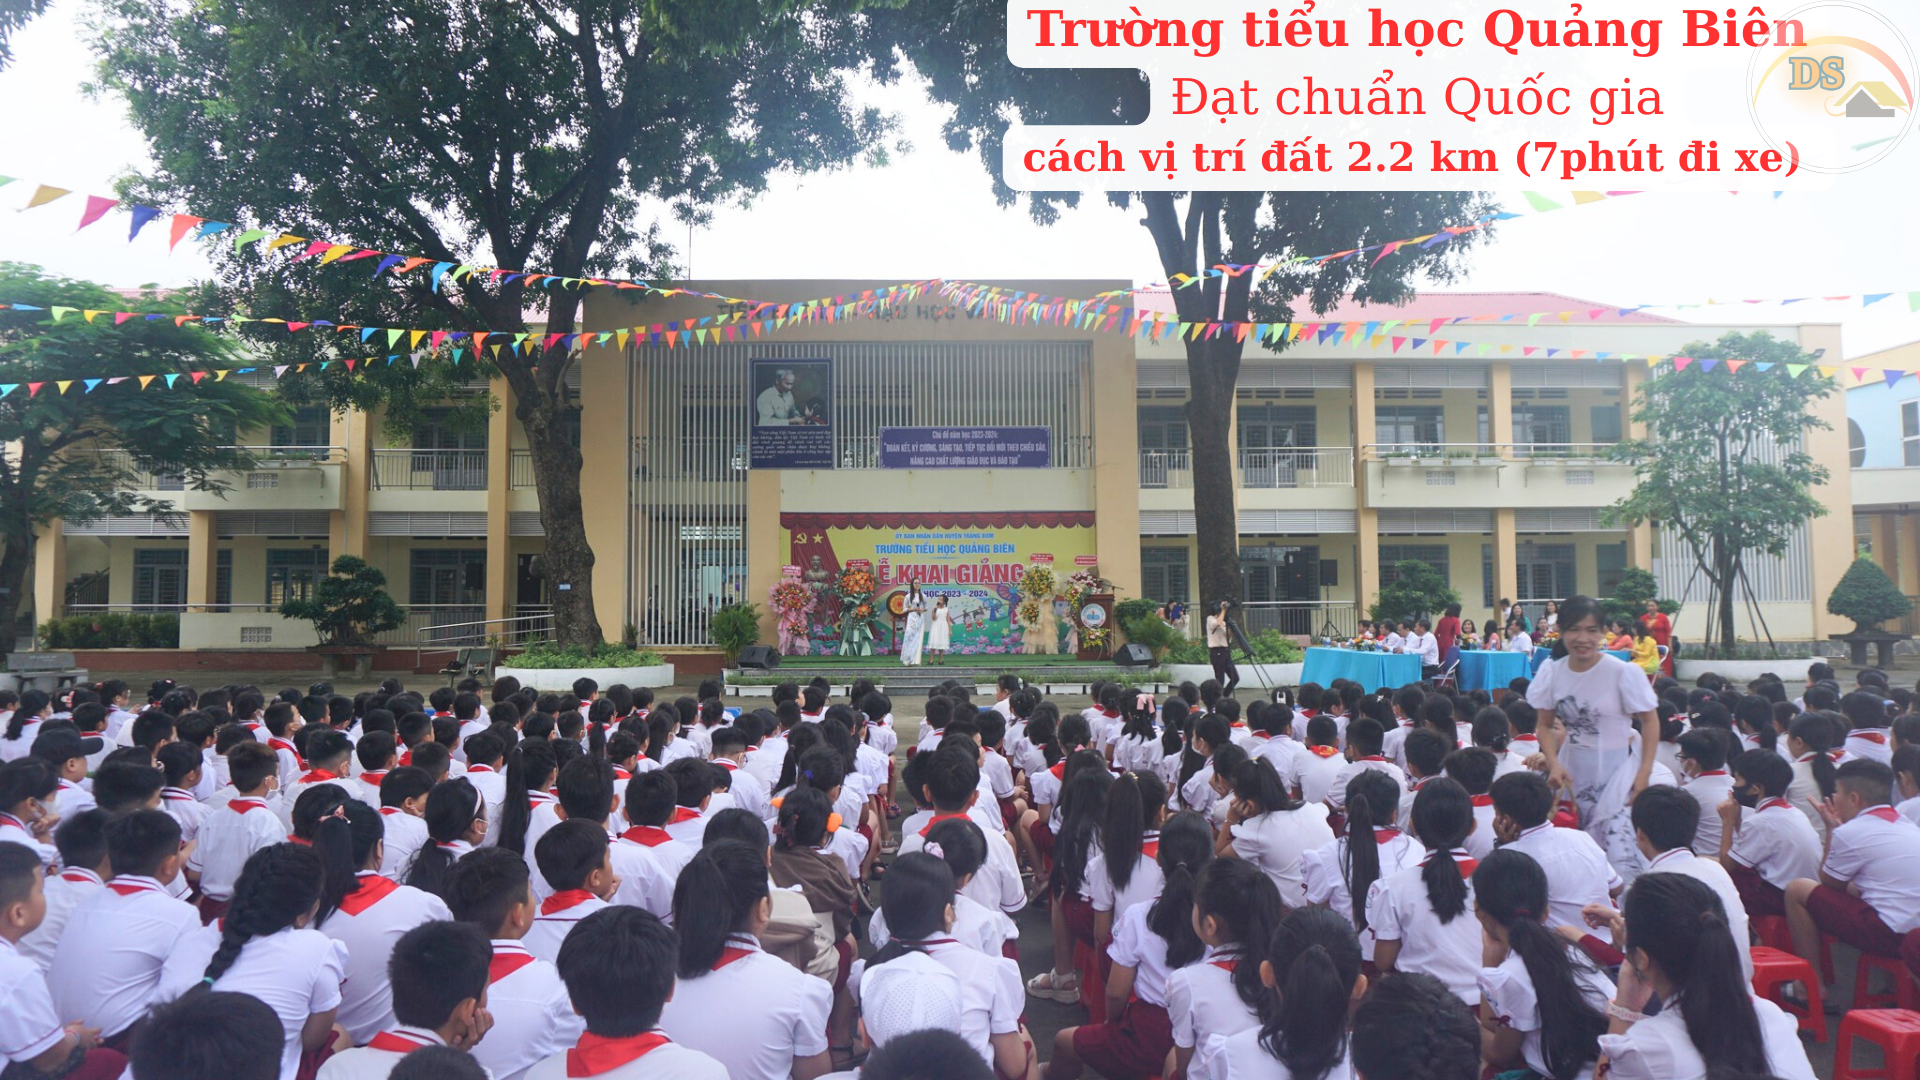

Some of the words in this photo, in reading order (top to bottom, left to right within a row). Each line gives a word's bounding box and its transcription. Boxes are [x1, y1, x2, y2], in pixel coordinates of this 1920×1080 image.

[937, 544, 956, 556] HỌC
[993, 542, 1015, 554] BIÊN
[896, 563, 949, 585] KHAI
[956, 557, 1024, 584] GIẢNG
